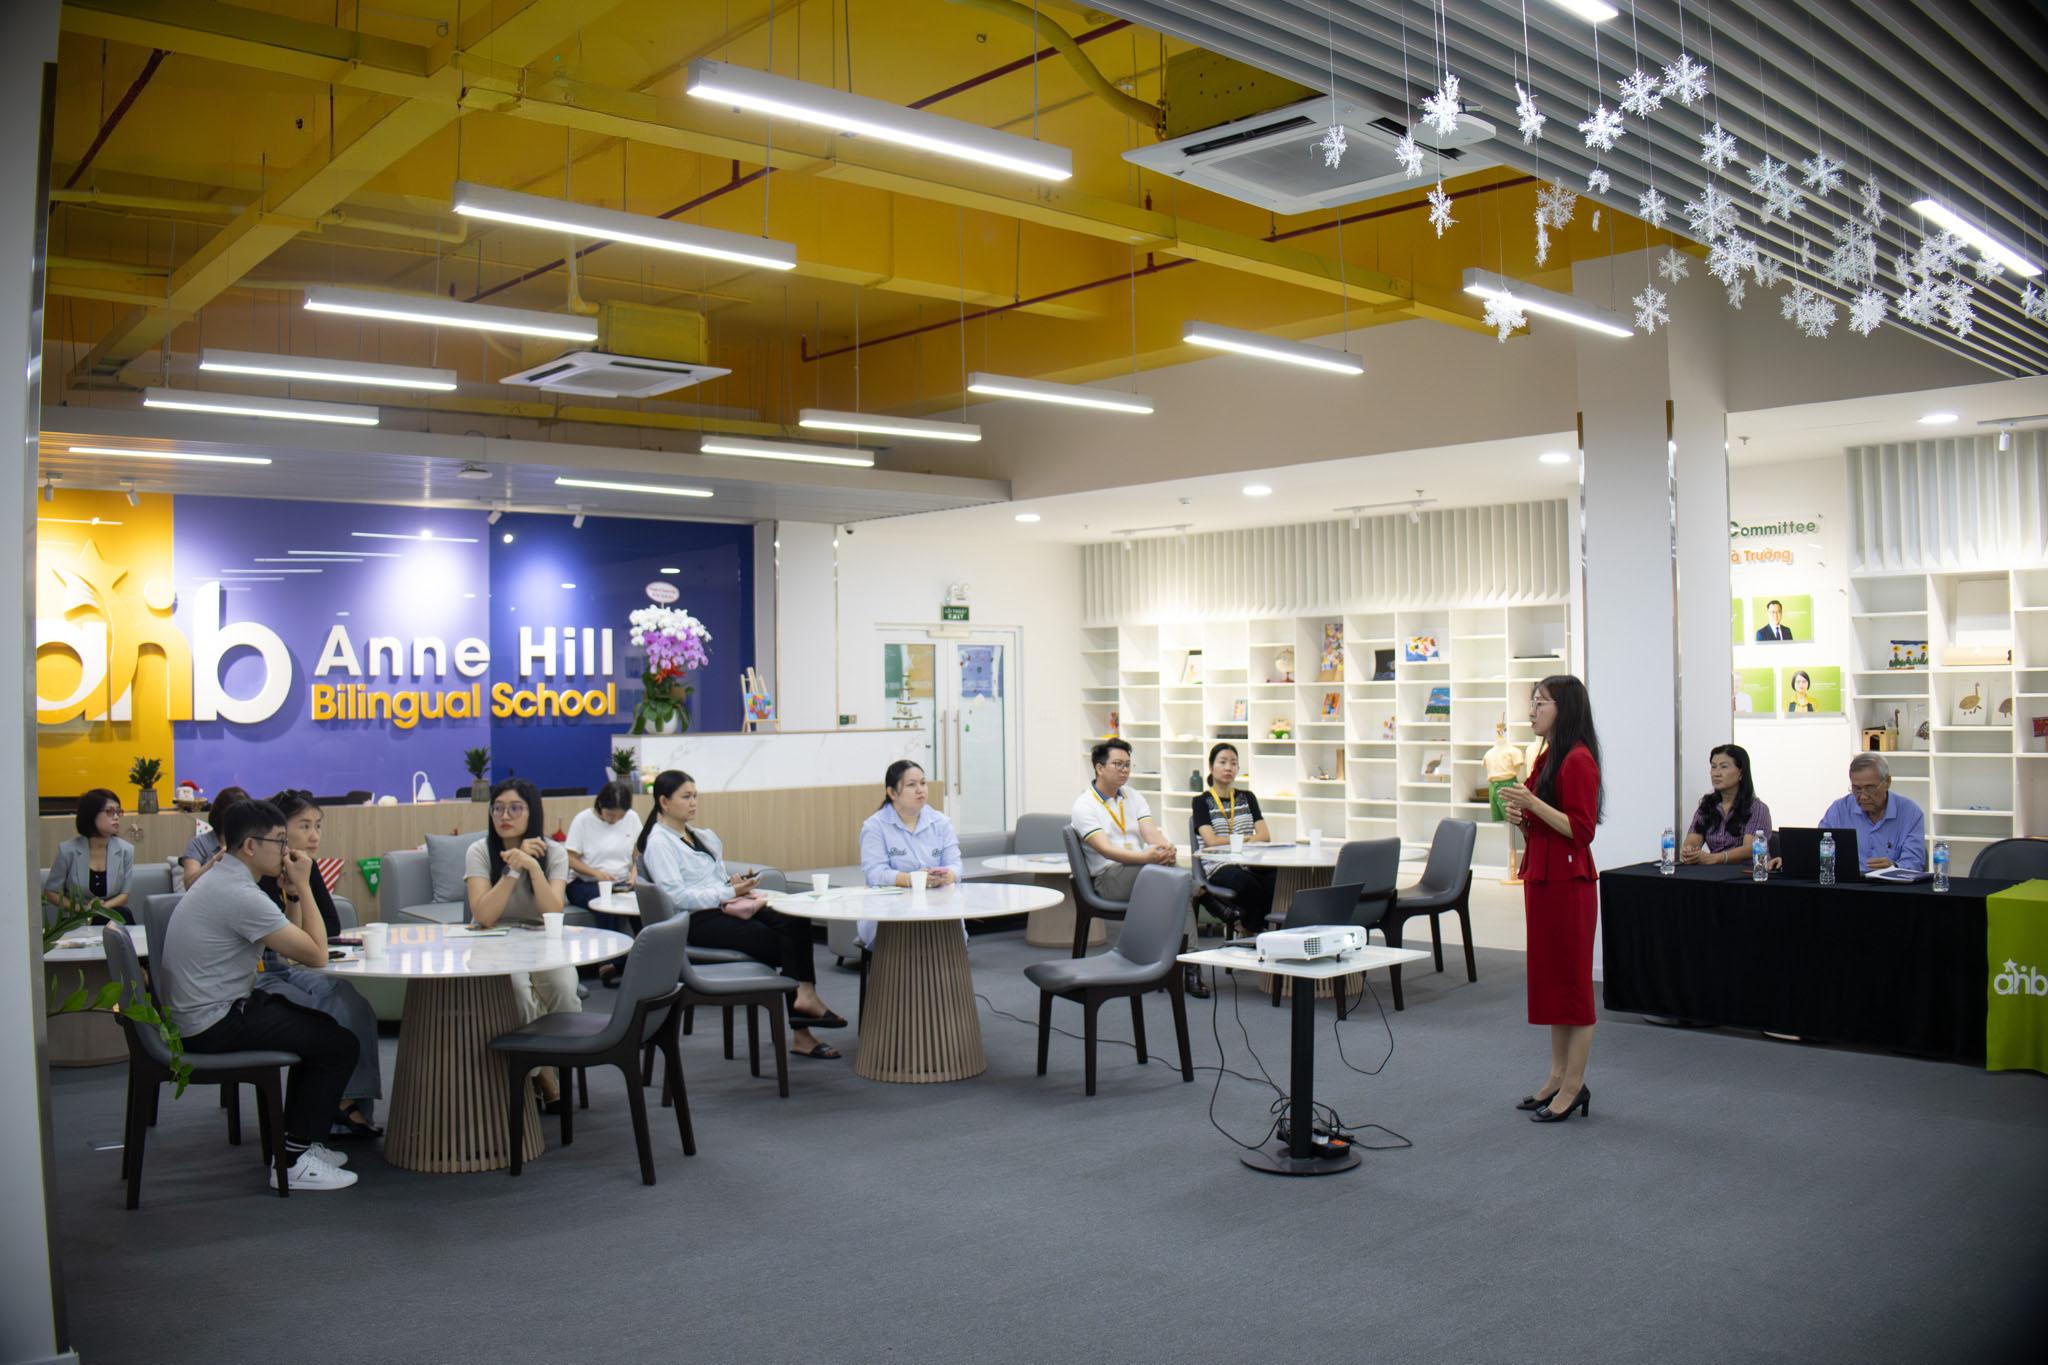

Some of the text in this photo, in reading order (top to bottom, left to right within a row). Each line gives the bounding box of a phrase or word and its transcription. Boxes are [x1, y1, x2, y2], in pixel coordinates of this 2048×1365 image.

[1730, 521, 1816, 537] Committee
[314, 624, 614, 677] Anne Hill
[311, 682, 616, 729] Bilingual School
